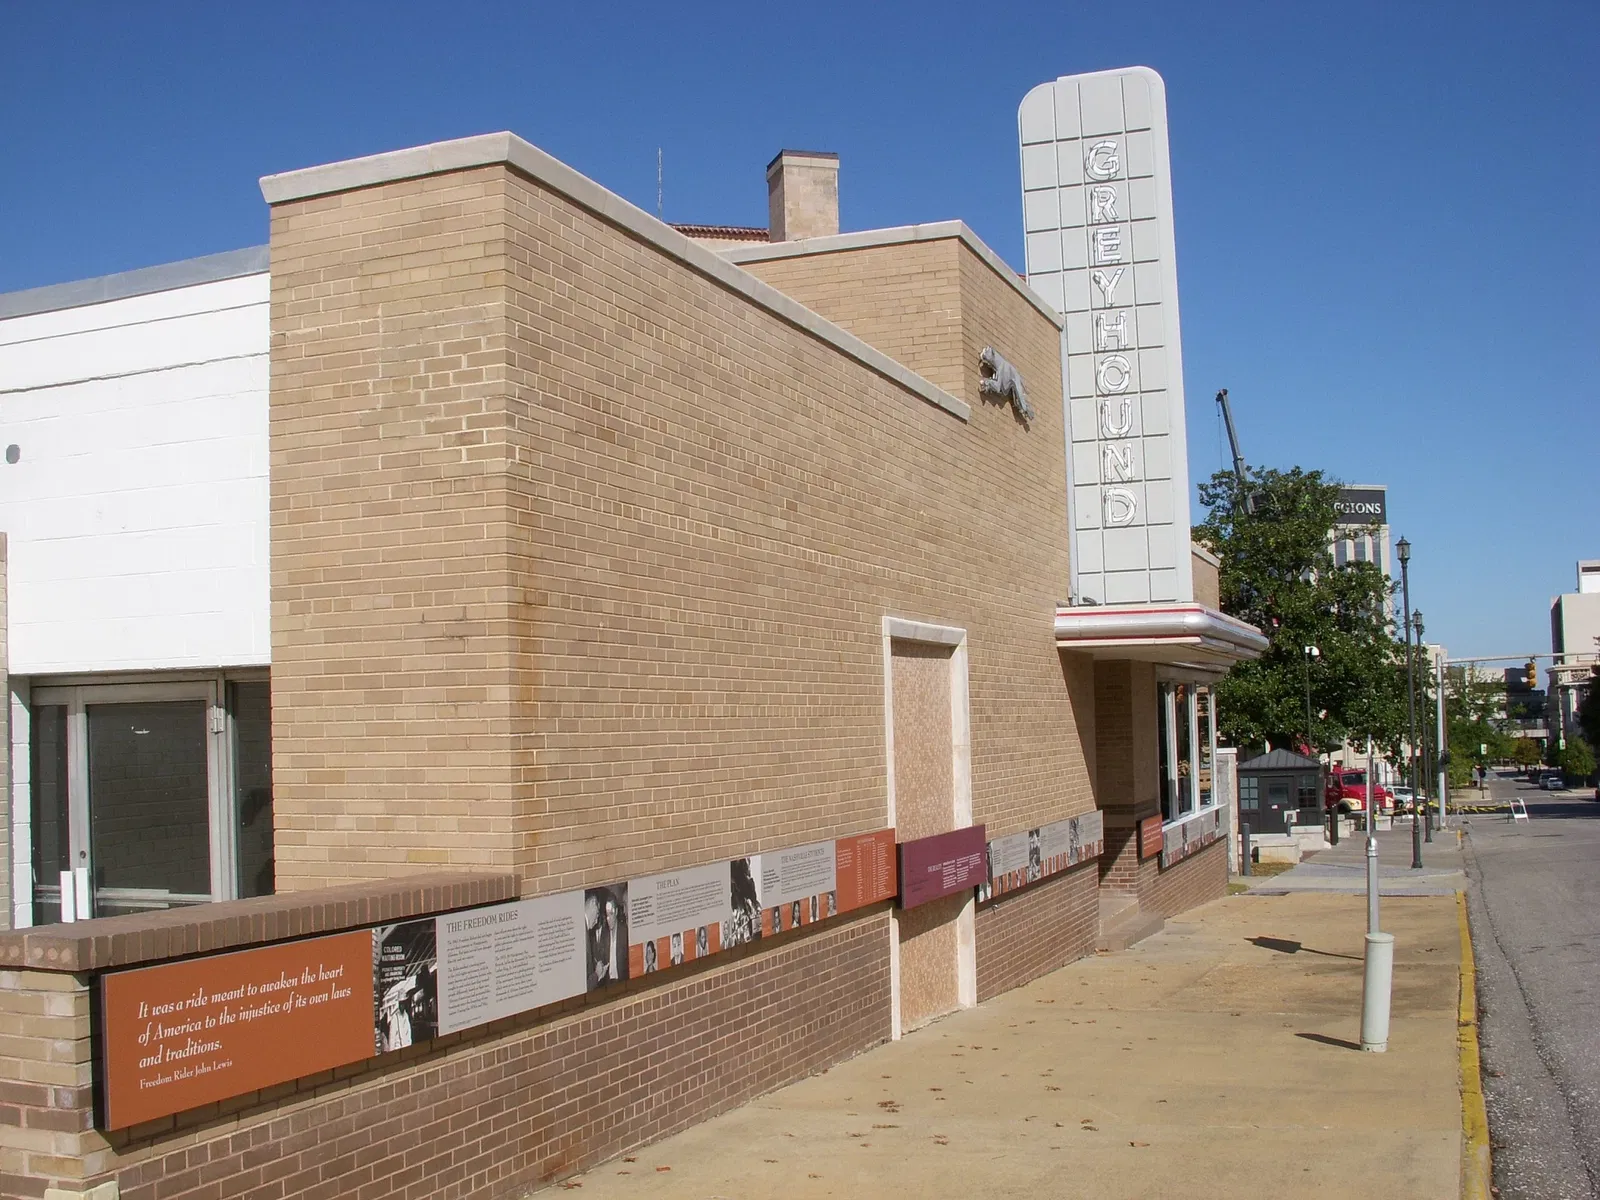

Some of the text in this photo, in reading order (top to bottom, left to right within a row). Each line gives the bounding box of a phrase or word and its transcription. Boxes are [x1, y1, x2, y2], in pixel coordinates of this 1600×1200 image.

[1086, 140, 1137, 526] GREYHOUND
[446, 909, 518, 933] THE FREEDOM RIDES
[137, 963, 344, 1019] It was a ride meant to awaken the heart
[138, 982, 351, 1047] of America to the injustice of its own laws
[139, 1037, 223, 1068] and traditions.
[140, 1058, 233, 1089] Freedom Rider John Lewis
